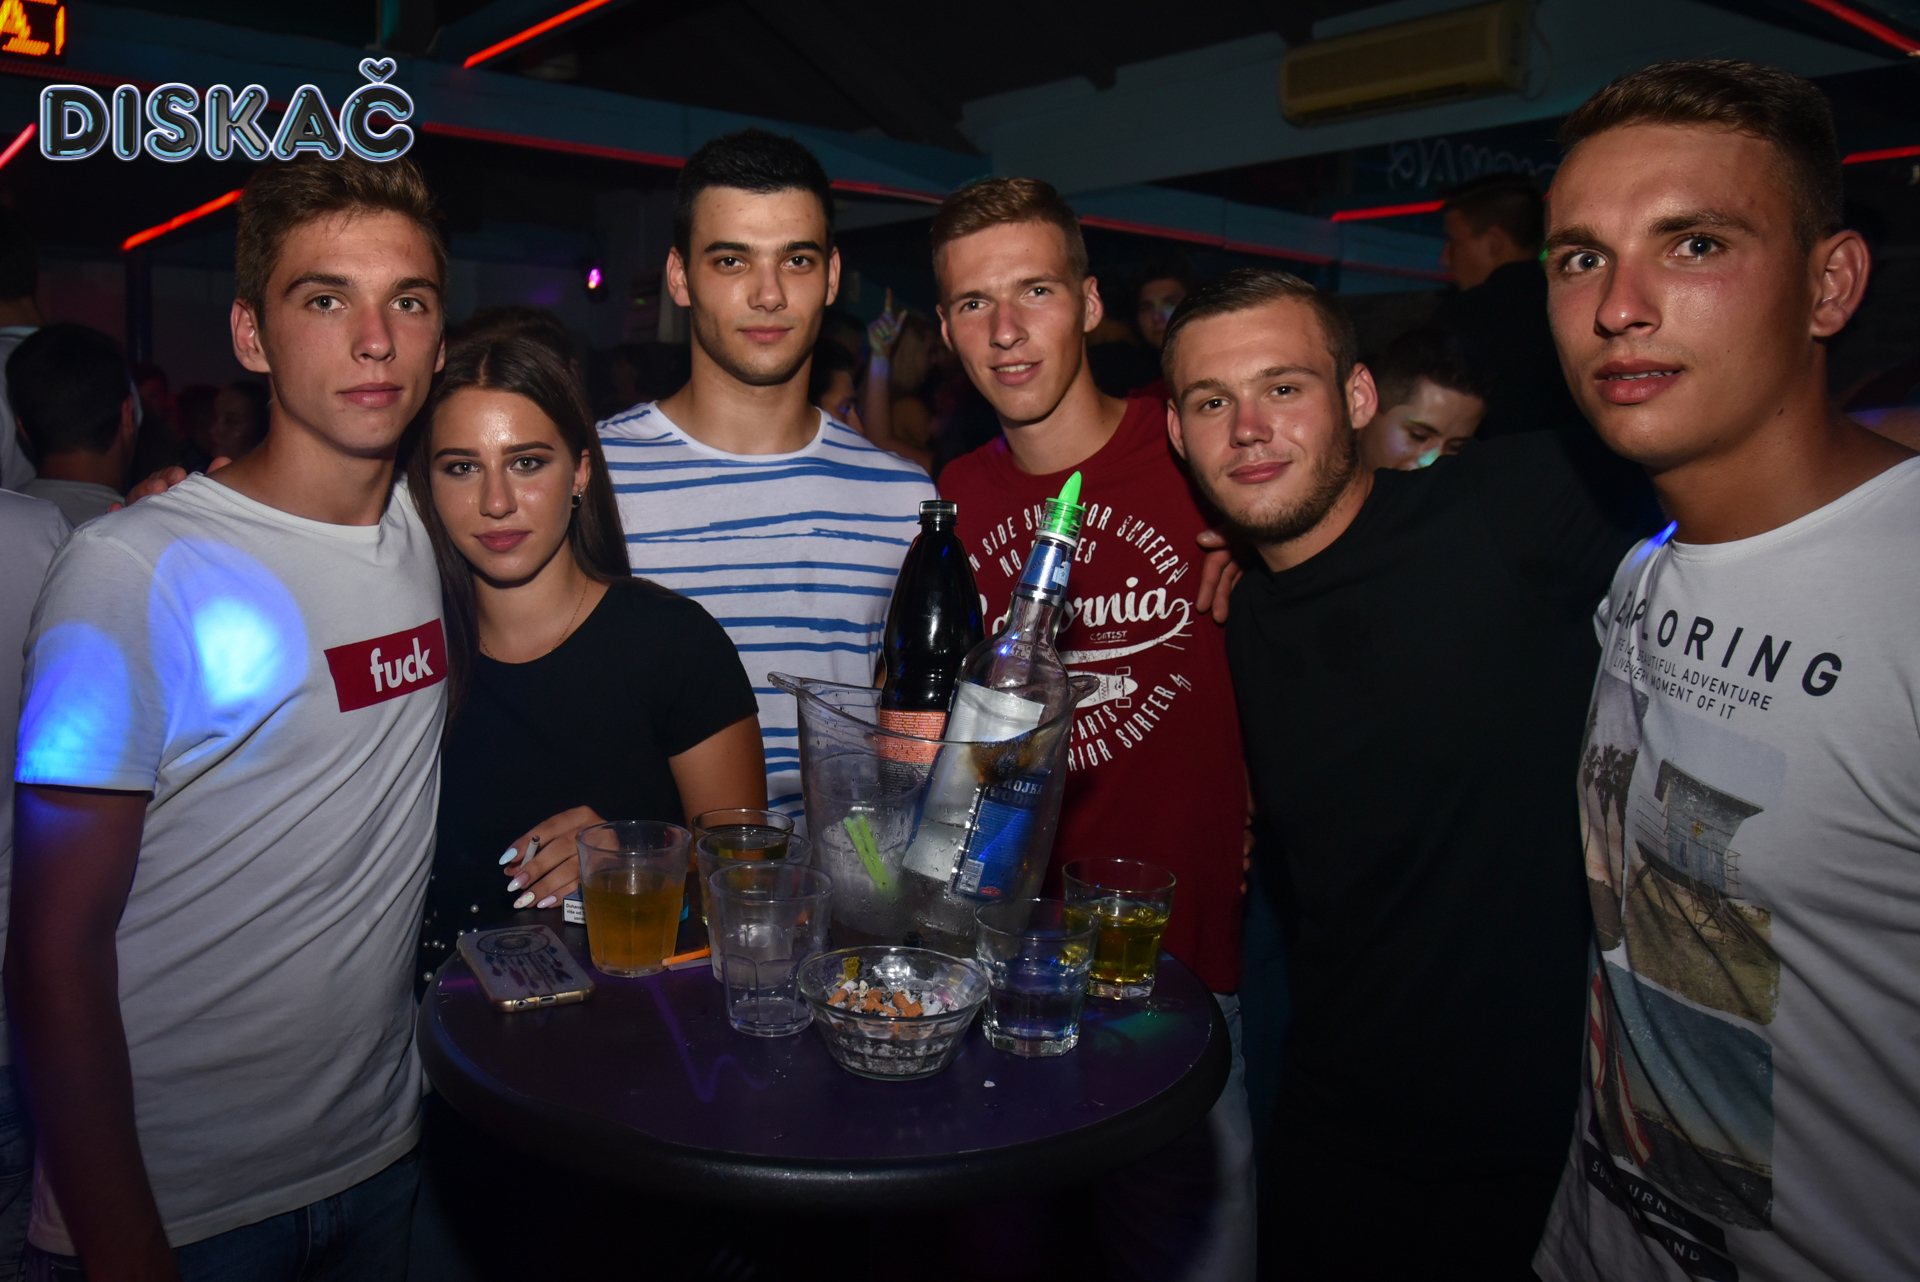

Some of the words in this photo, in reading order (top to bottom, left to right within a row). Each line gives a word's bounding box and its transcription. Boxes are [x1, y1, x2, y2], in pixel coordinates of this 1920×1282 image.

[982, 516, 1017, 556] SIDE
[1117, 515, 1179, 574] SURFER
[999, 549, 1022, 577] NO
[370, 637, 434, 692] fuck
[1650, 674, 1693, 703] MOMENT
[1697, 695, 1716, 711] OF
[1720, 703, 1736, 719] IT
[1681, 668, 1772, 711] ADVENTURE
[1070, 705, 1117, 742] ARTS
[1115, 685, 1176, 748] SURFER
